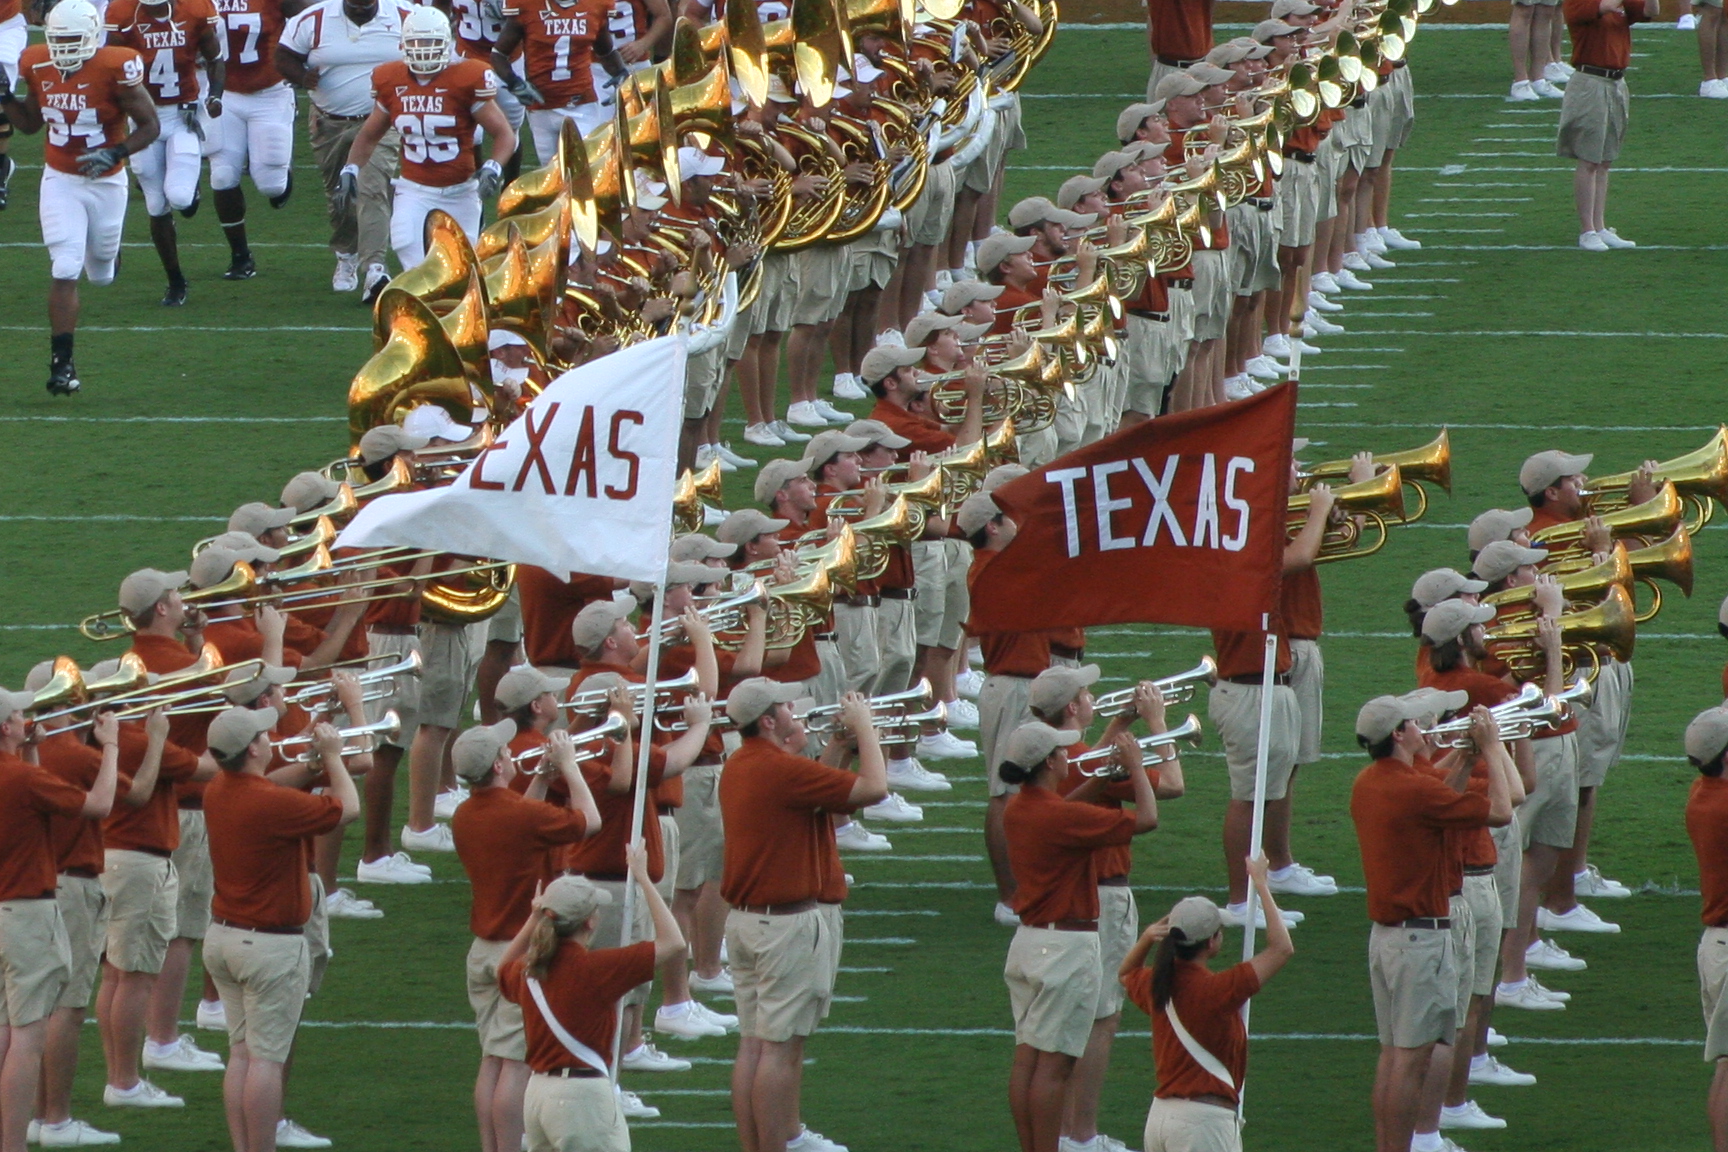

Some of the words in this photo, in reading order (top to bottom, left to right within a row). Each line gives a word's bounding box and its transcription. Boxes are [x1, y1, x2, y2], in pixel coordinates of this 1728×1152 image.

[143, 31, 186, 48] TEXAS
[543, 18, 587, 36] TEXAS
[148, 49, 180, 98] 4
[551, 35, 572, 82] 1
[46, 93, 87, 110] TEXAS
[400, 95, 444, 113] TEXAS
[394, 114, 461, 164] 95
[470, 410, 647, 501] EXAS
[1042, 453, 1257, 557] TEXAS
